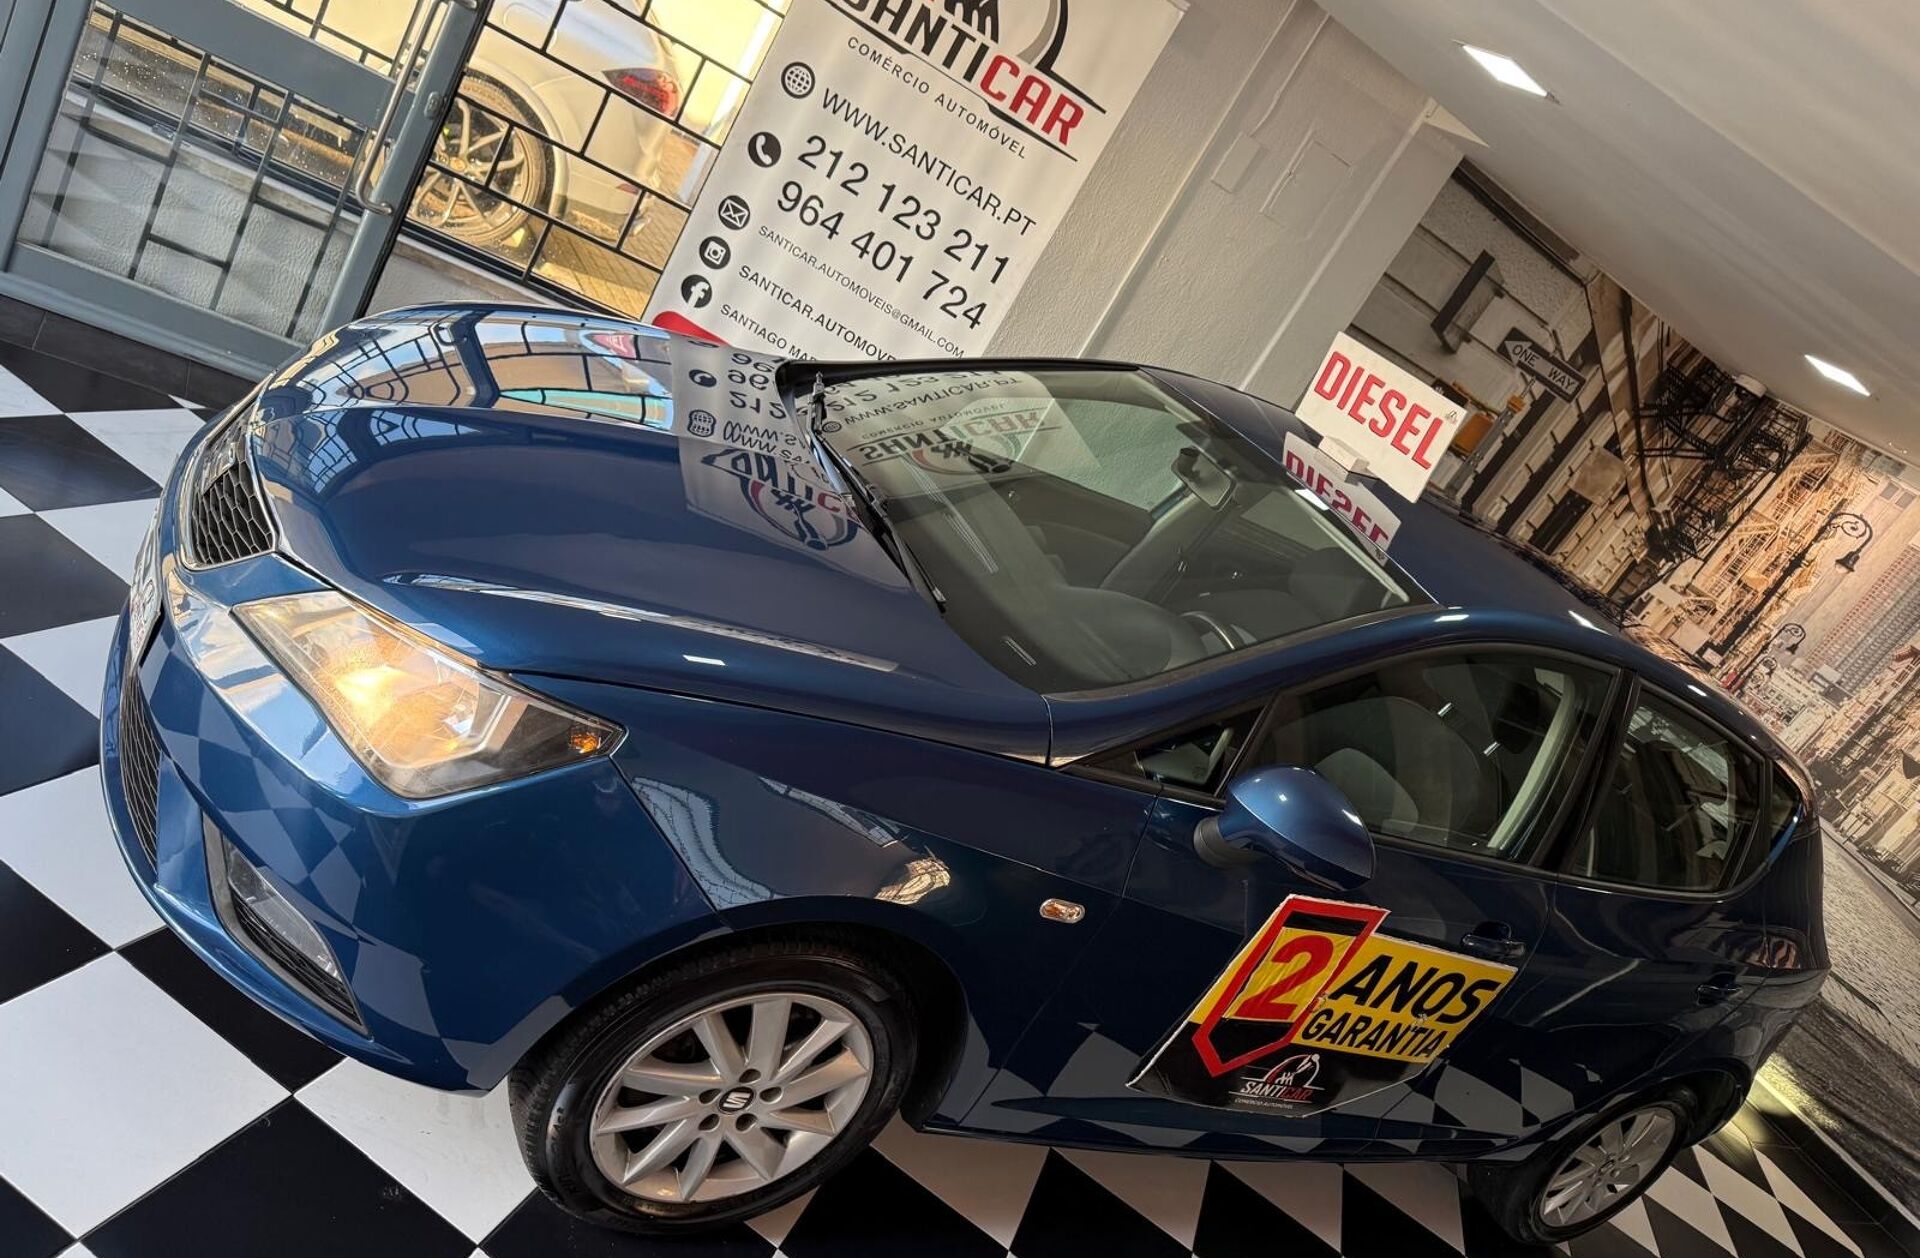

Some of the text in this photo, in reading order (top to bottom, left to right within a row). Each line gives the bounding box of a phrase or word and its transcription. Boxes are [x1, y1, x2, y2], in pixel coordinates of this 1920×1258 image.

[843, 0, 1084, 146] ANTICAR
[847, 36, 1026, 159] COMÉRCIO AUTOMÓVEL
[798, 135, 1009, 284] 212 123 211
[822, 88, 1037, 237] WWW.SANTICAR.PT
[758, 225, 965, 360] SANTICAR.AUTOMOVEIS@GMAIL.COM
[777, 181, 987, 329] 964 401 724
[720, 304, 787, 350] SANTIAGO
[1513, 345, 1575, 390] ONE WAY
[1313, 351, 1443, 470] DIESEL
[1233, 934, 1501, 1024] 2 ANOS
[1302, 1009, 1448, 1058] GARANTIA
[1240, 1081, 1314, 1100] SANTICAR
